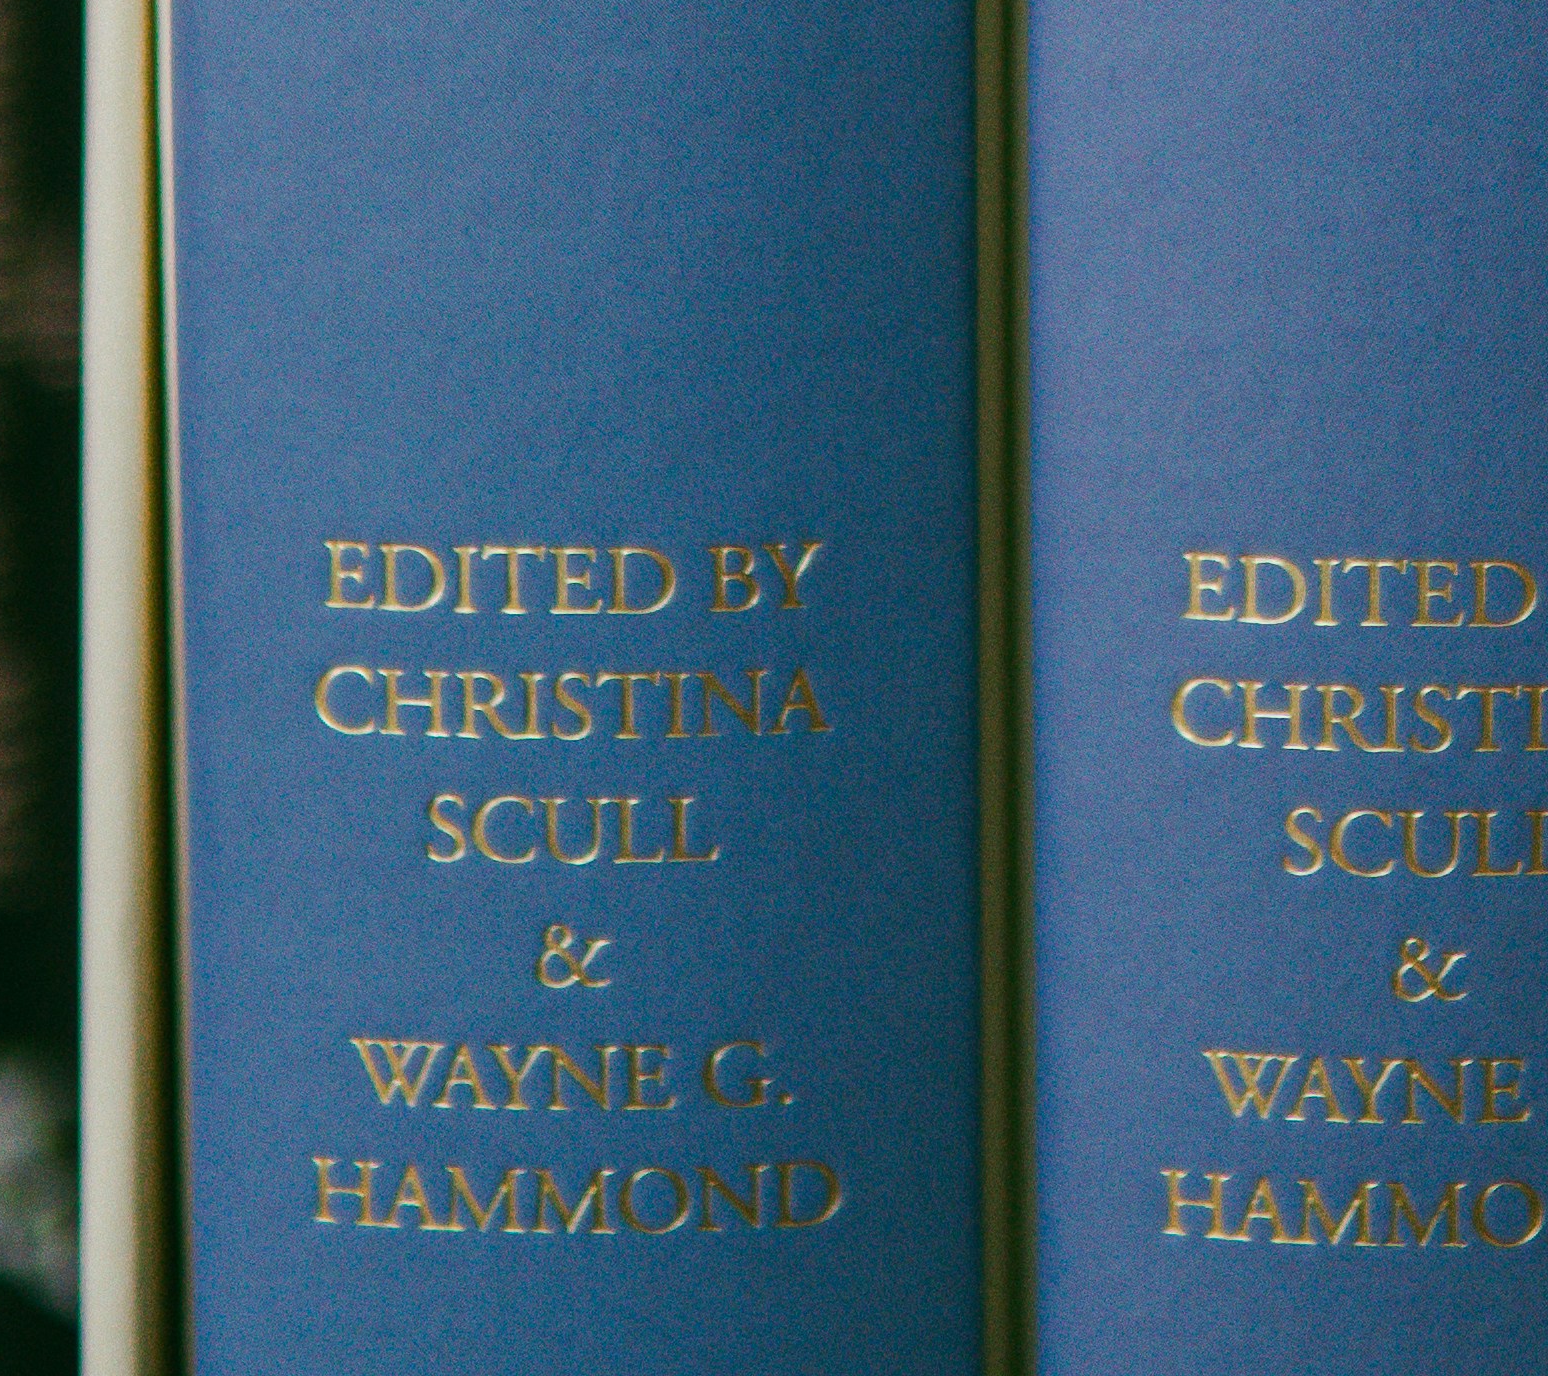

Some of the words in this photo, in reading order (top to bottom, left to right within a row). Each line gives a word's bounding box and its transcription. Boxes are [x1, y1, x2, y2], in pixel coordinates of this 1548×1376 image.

[325, 538, 677, 614] EDITED
[708, 539, 822, 613] BY
[1182, 548, 1538, 628] EDITED
[314, 663, 831, 740] CHRISTINA
[426, 791, 719, 864] SCULL
[535, 923, 610, 988] &
[1390, 935, 1466, 1002] &
[351, 1035, 678, 1112] WAYNE
[702, 1040, 795, 1110] G.
[1202, 1047, 1531, 1126] WAYNE
[314, 1155, 843, 1235] HAMMOND
